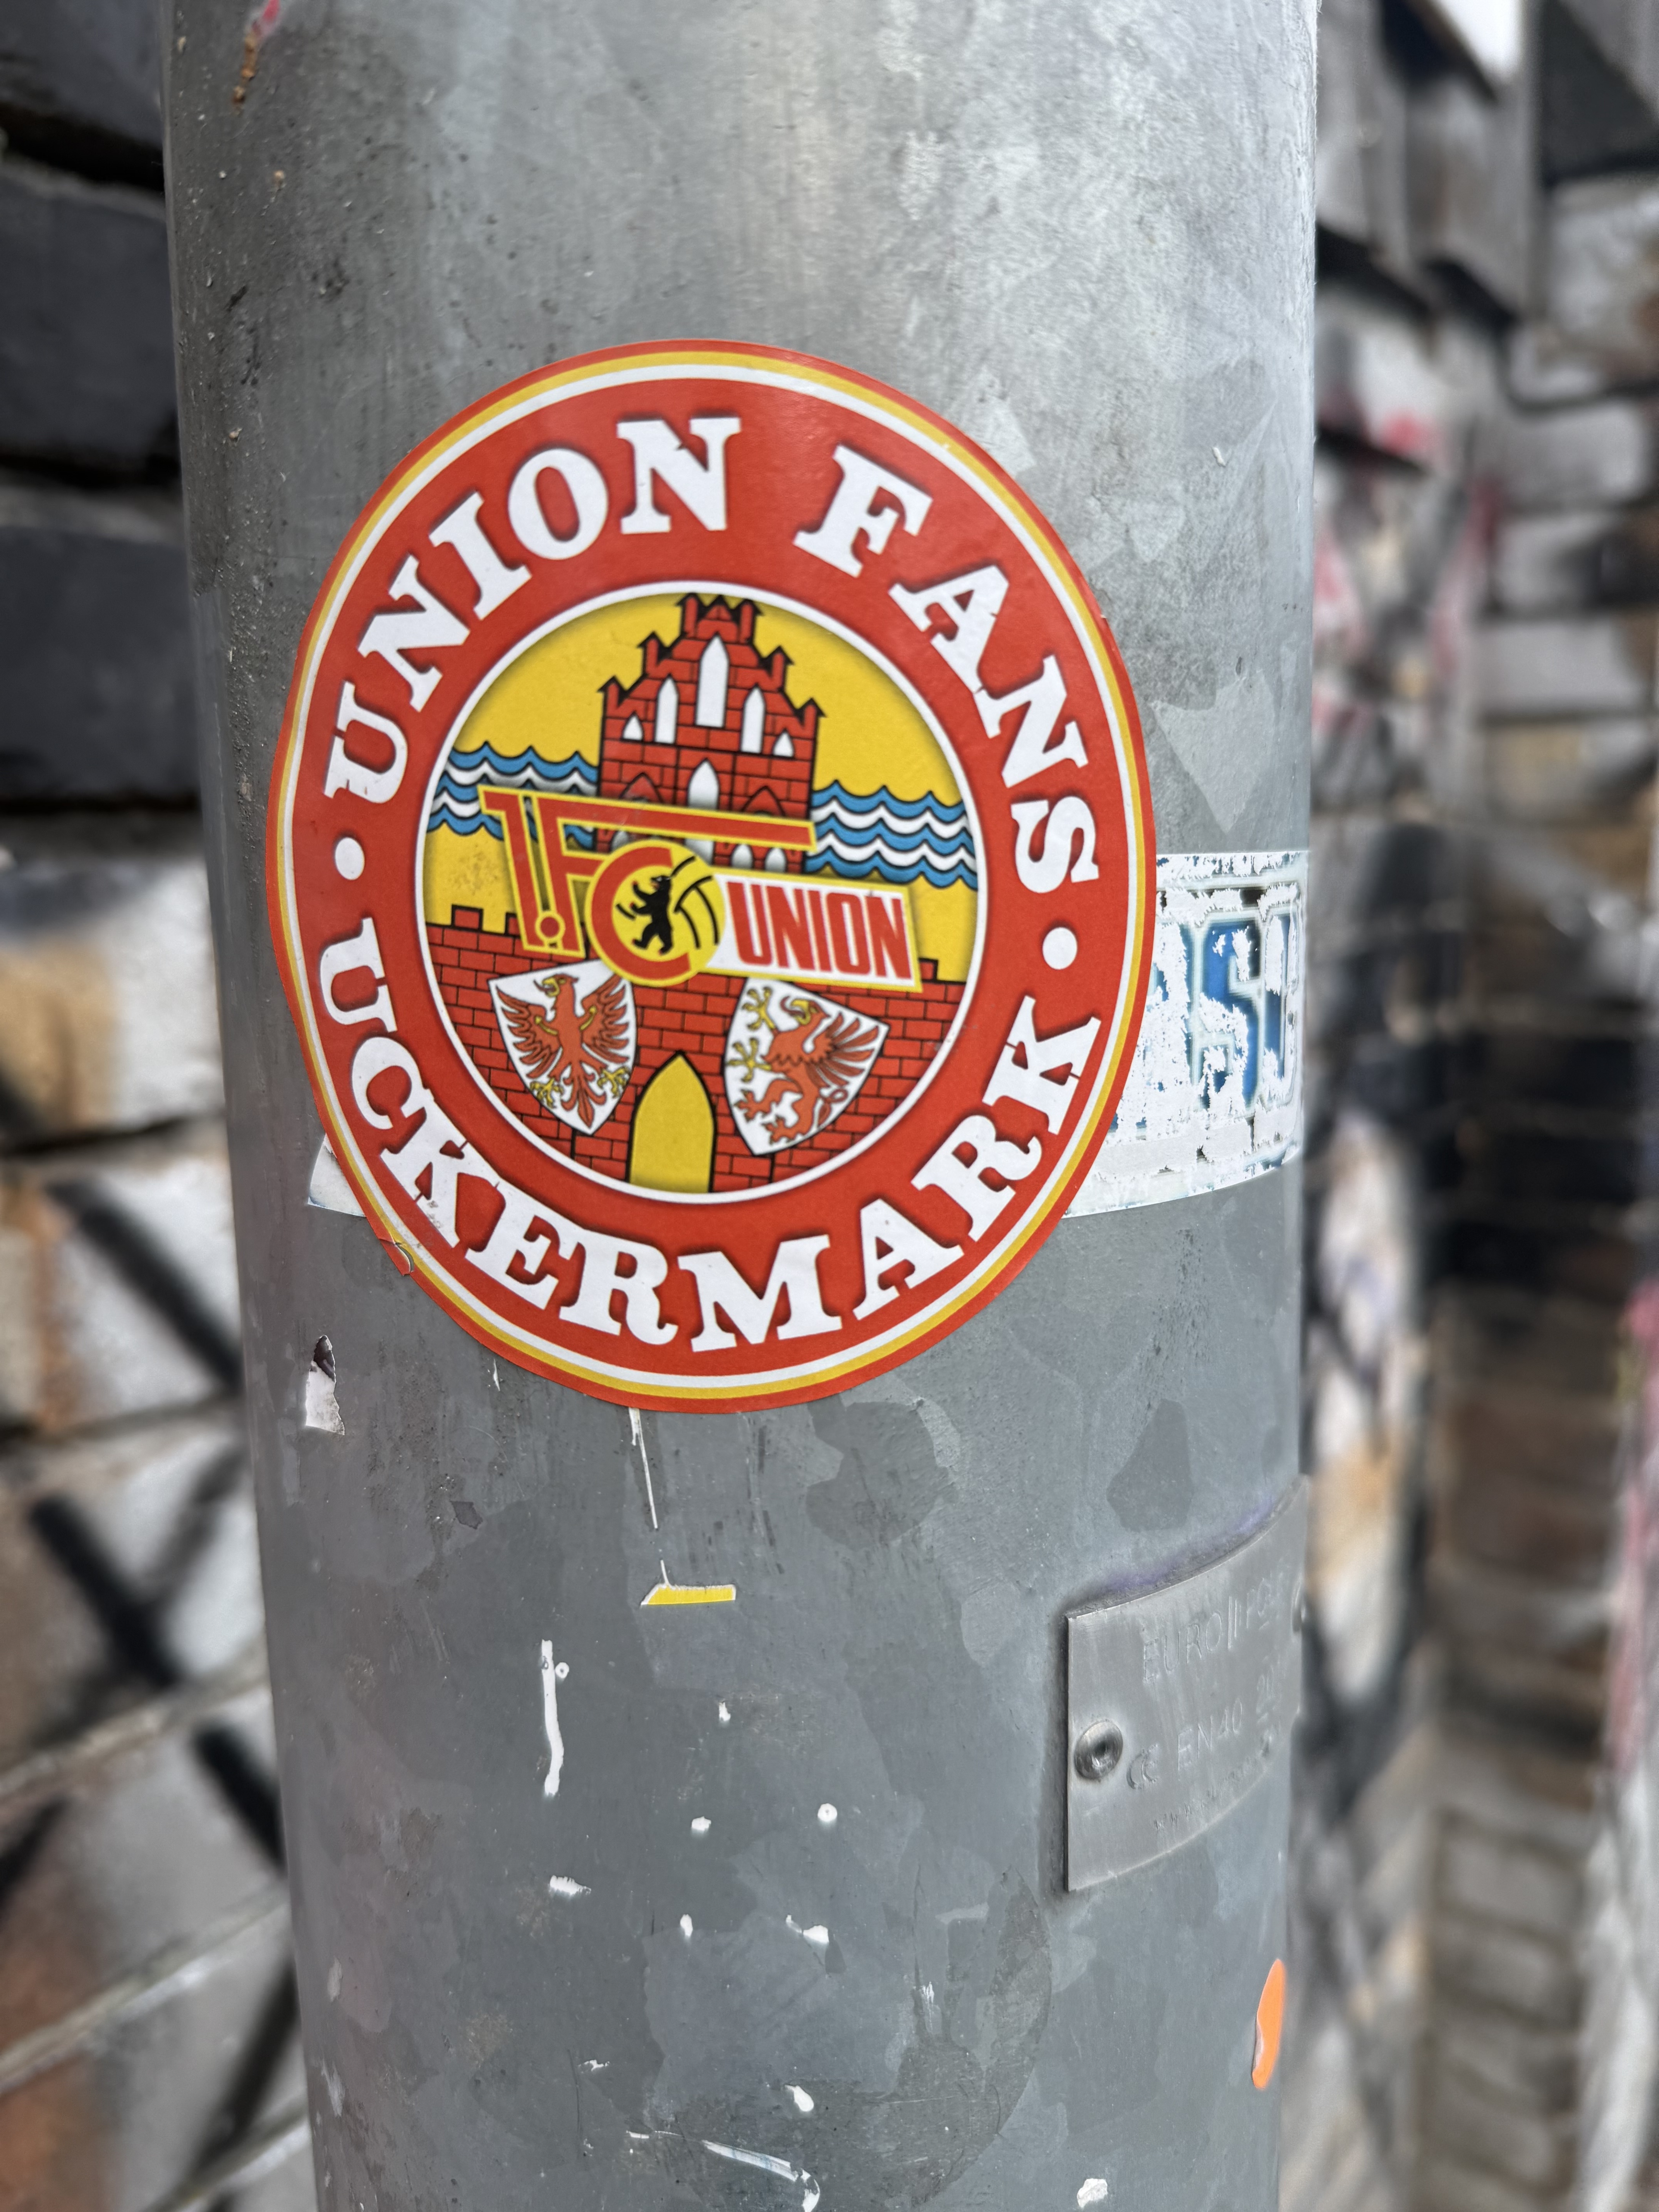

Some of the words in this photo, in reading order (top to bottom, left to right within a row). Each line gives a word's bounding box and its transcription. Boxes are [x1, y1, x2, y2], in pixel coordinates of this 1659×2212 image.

[324, 417, 740, 803] UNION
[794, 445, 1099, 893] FANS
[319, 917, 1101, 1352] UCKERMARK
[725, 880, 913, 981] UNION
